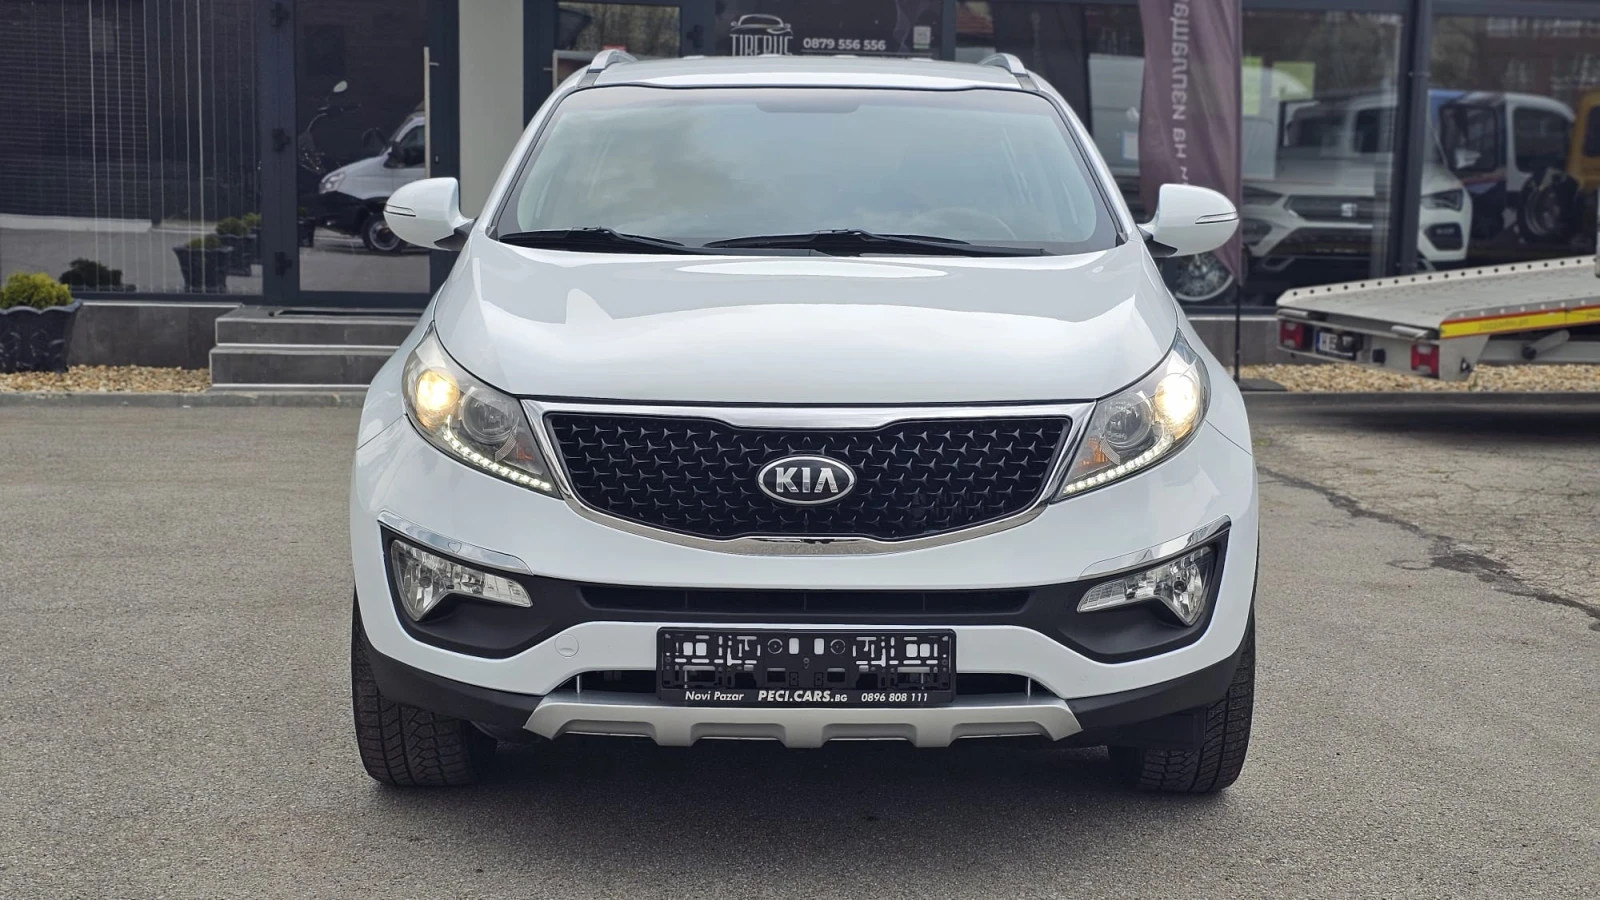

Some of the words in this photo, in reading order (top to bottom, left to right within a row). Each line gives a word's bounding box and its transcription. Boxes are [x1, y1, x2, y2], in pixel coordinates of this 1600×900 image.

[803, 38, 835, 49] 0879
[838, 38, 861, 50] 556
[863, 39, 886, 51] 556
[775, 467, 839, 493] KIA
[685, 691, 711, 701] Novi
[713, 691, 744, 701] Pazar
[861, 692, 886, 702] 0896
[888, 692, 908, 702] 808
[911, 693, 928, 702] 111
